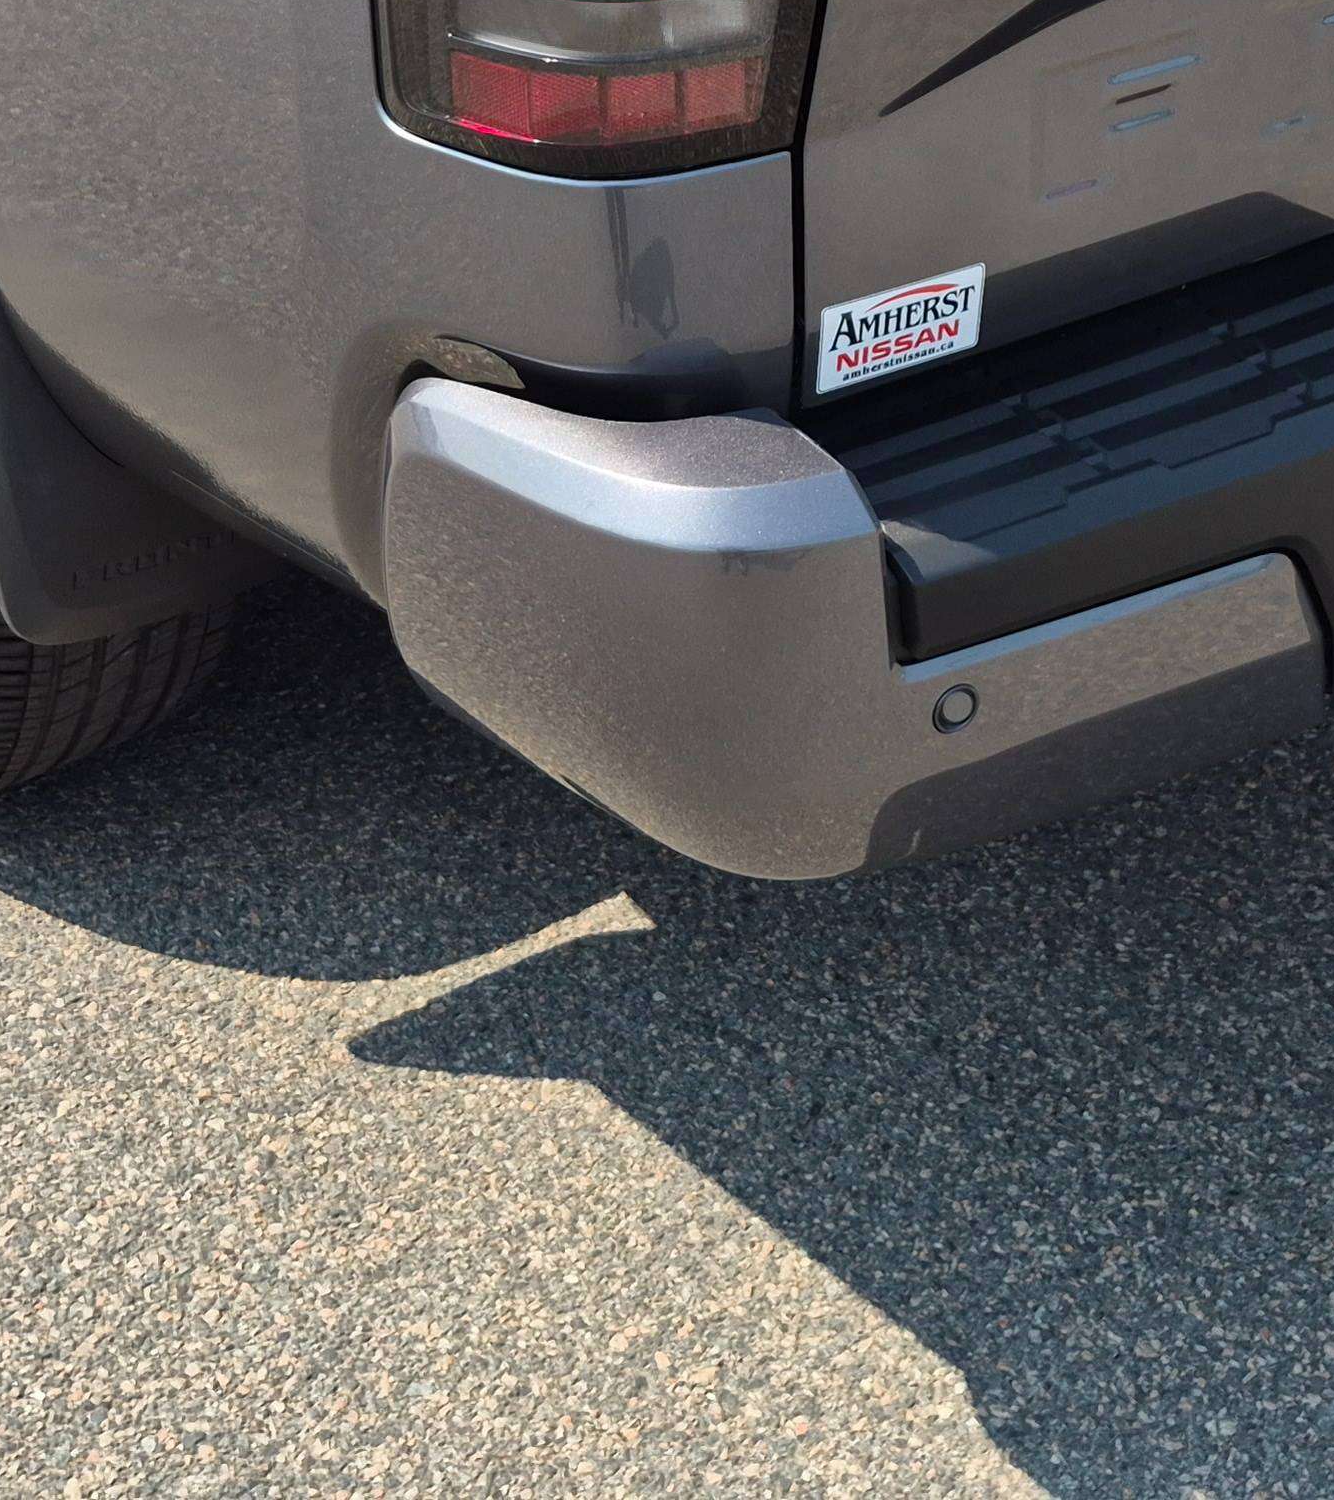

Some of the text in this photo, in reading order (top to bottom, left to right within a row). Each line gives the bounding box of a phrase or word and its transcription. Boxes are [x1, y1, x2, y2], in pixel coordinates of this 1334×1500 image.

[829, 285, 975, 353] AMHERST
[836, 319, 960, 372] NISSAN
[843, 341, 955, 381] amherstnissan.ca
